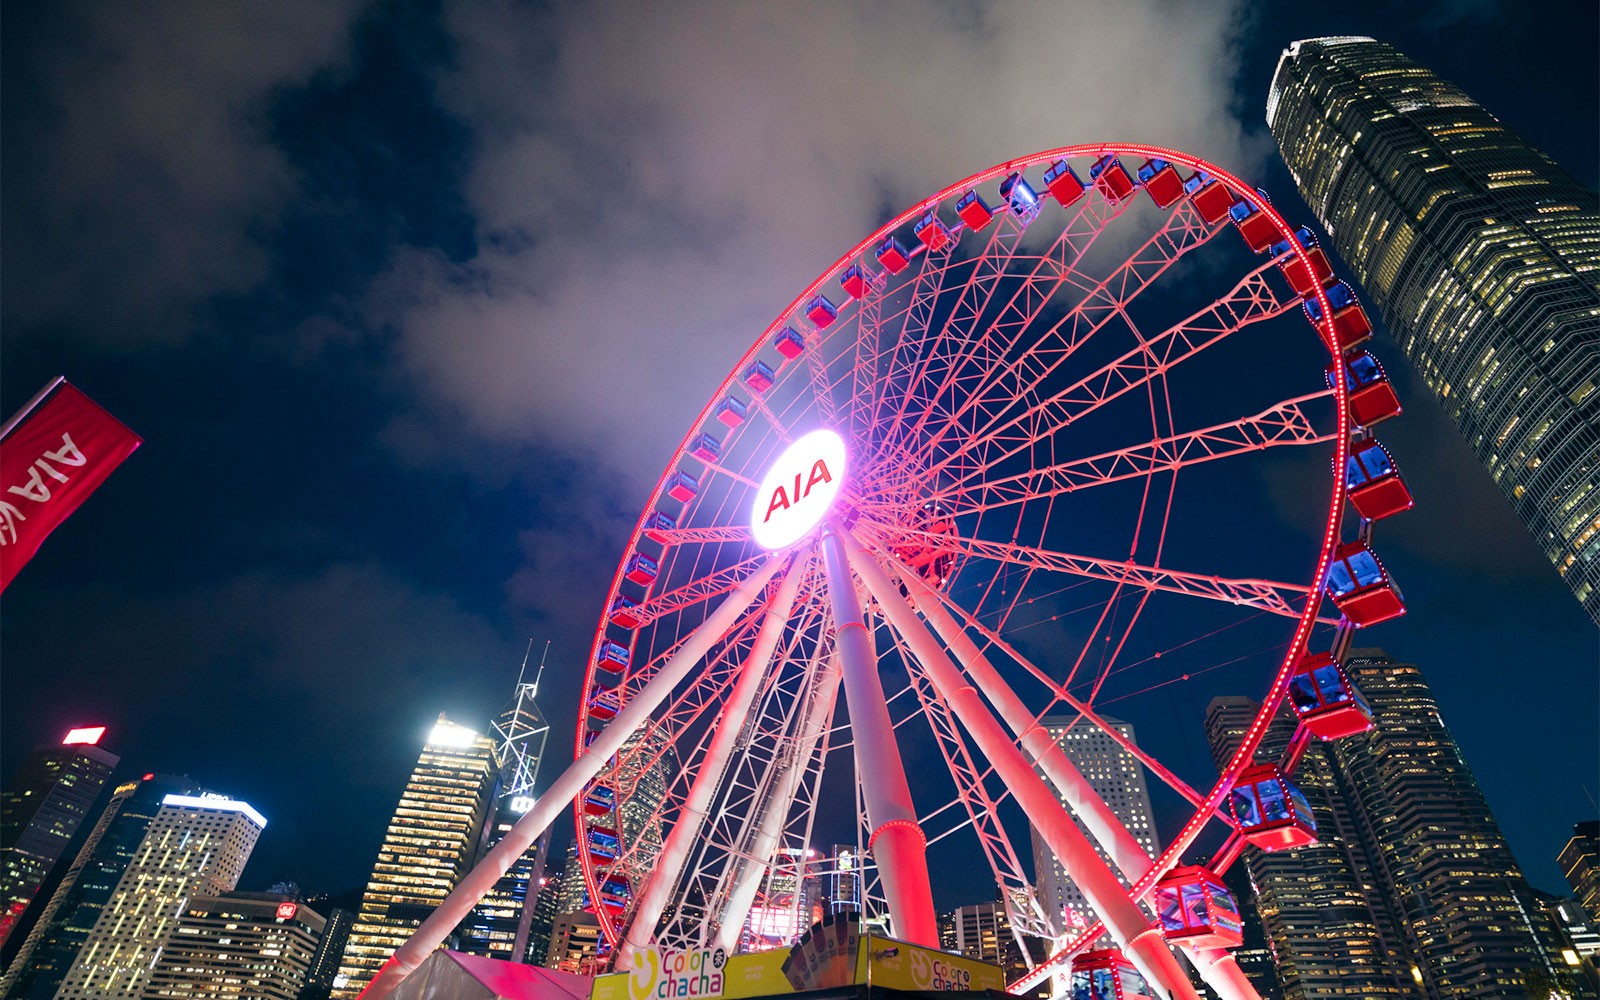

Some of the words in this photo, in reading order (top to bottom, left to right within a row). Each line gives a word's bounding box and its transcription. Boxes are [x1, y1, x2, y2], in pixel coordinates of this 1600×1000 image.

[7, 432, 87, 503] AIA
[763, 458, 832, 523] AIA
[663, 948, 710, 975] Color
[658, 973, 721, 998] chacha
